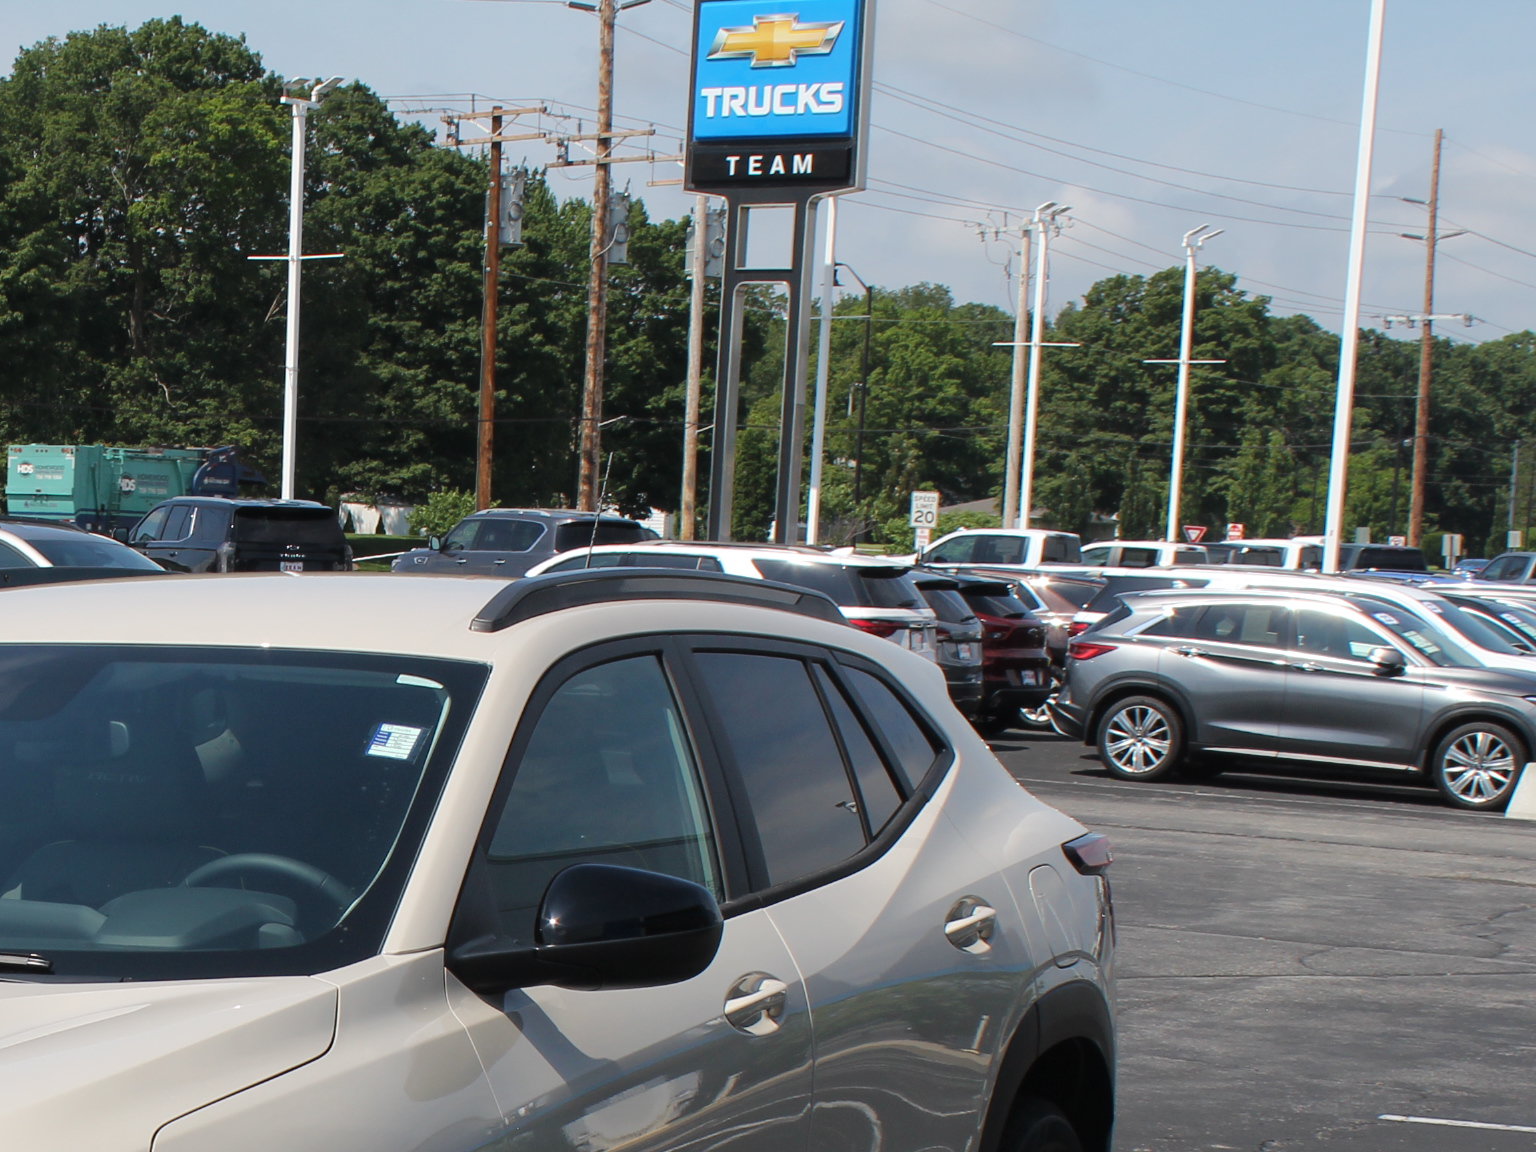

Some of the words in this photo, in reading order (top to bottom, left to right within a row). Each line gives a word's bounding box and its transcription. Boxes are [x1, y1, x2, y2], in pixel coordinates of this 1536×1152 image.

[701, 82, 844, 118] TRUCKS
[726, 153, 813, 176] TEAM
[17, 464, 34, 474] HDS
[914, 510, 934, 523] 20
